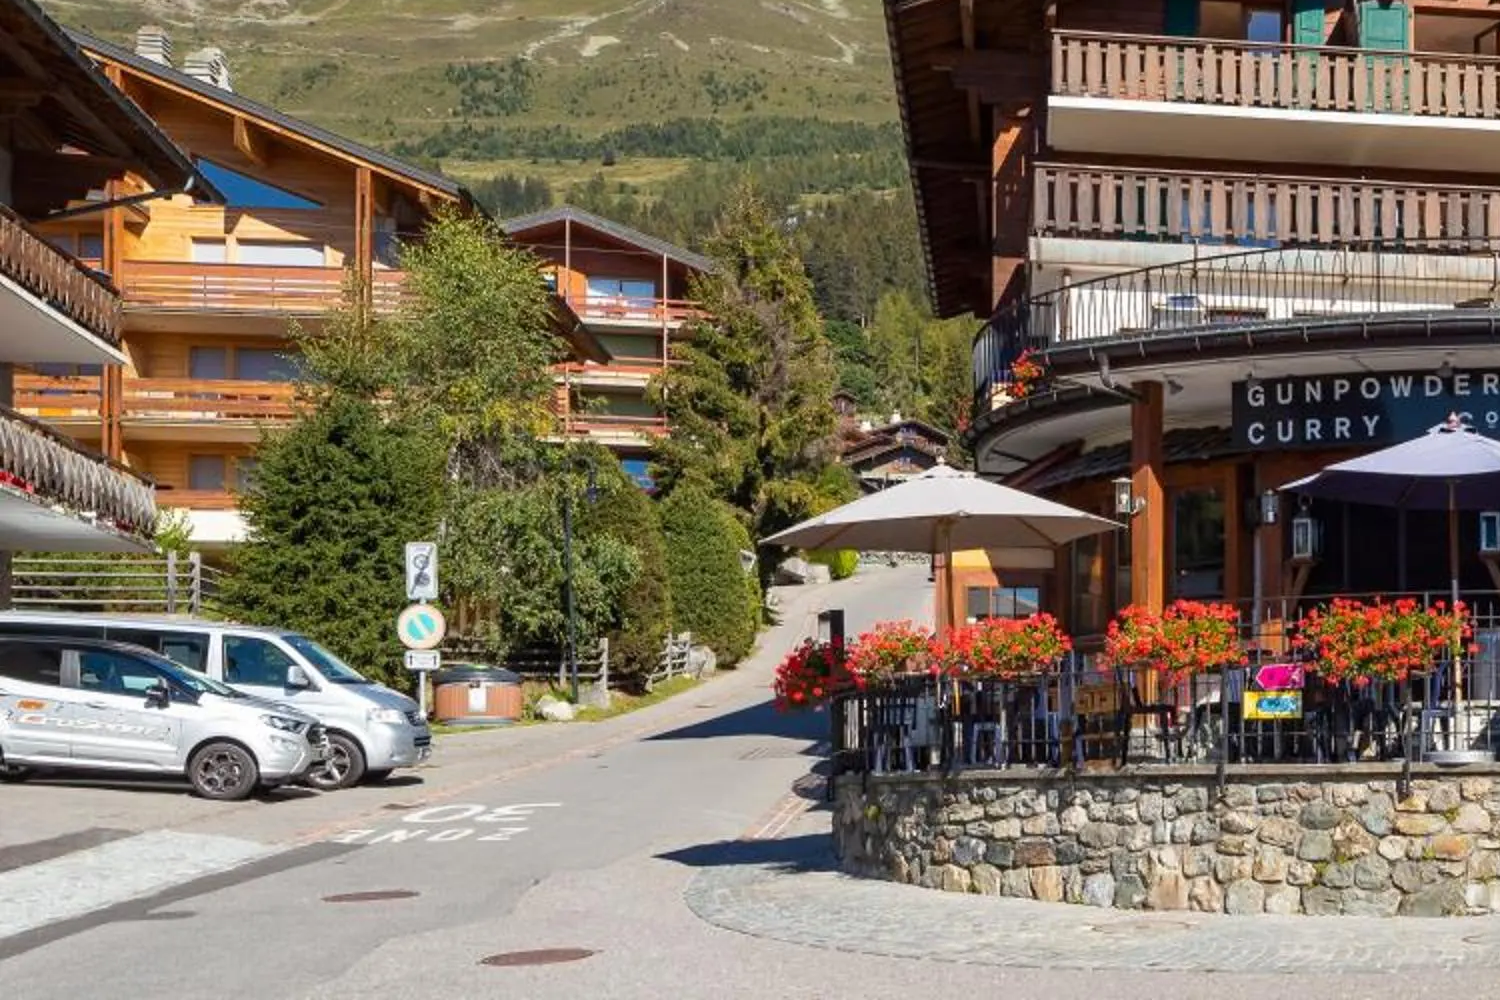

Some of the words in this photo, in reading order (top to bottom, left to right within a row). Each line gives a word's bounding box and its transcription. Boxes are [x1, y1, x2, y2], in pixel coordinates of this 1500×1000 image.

[1247, 373, 1499, 408] GUNPOWDER
[1247, 414, 1381, 445] CURRY
[402, 802, 561, 823] 30
[332, 826, 530, 845] ZONE
